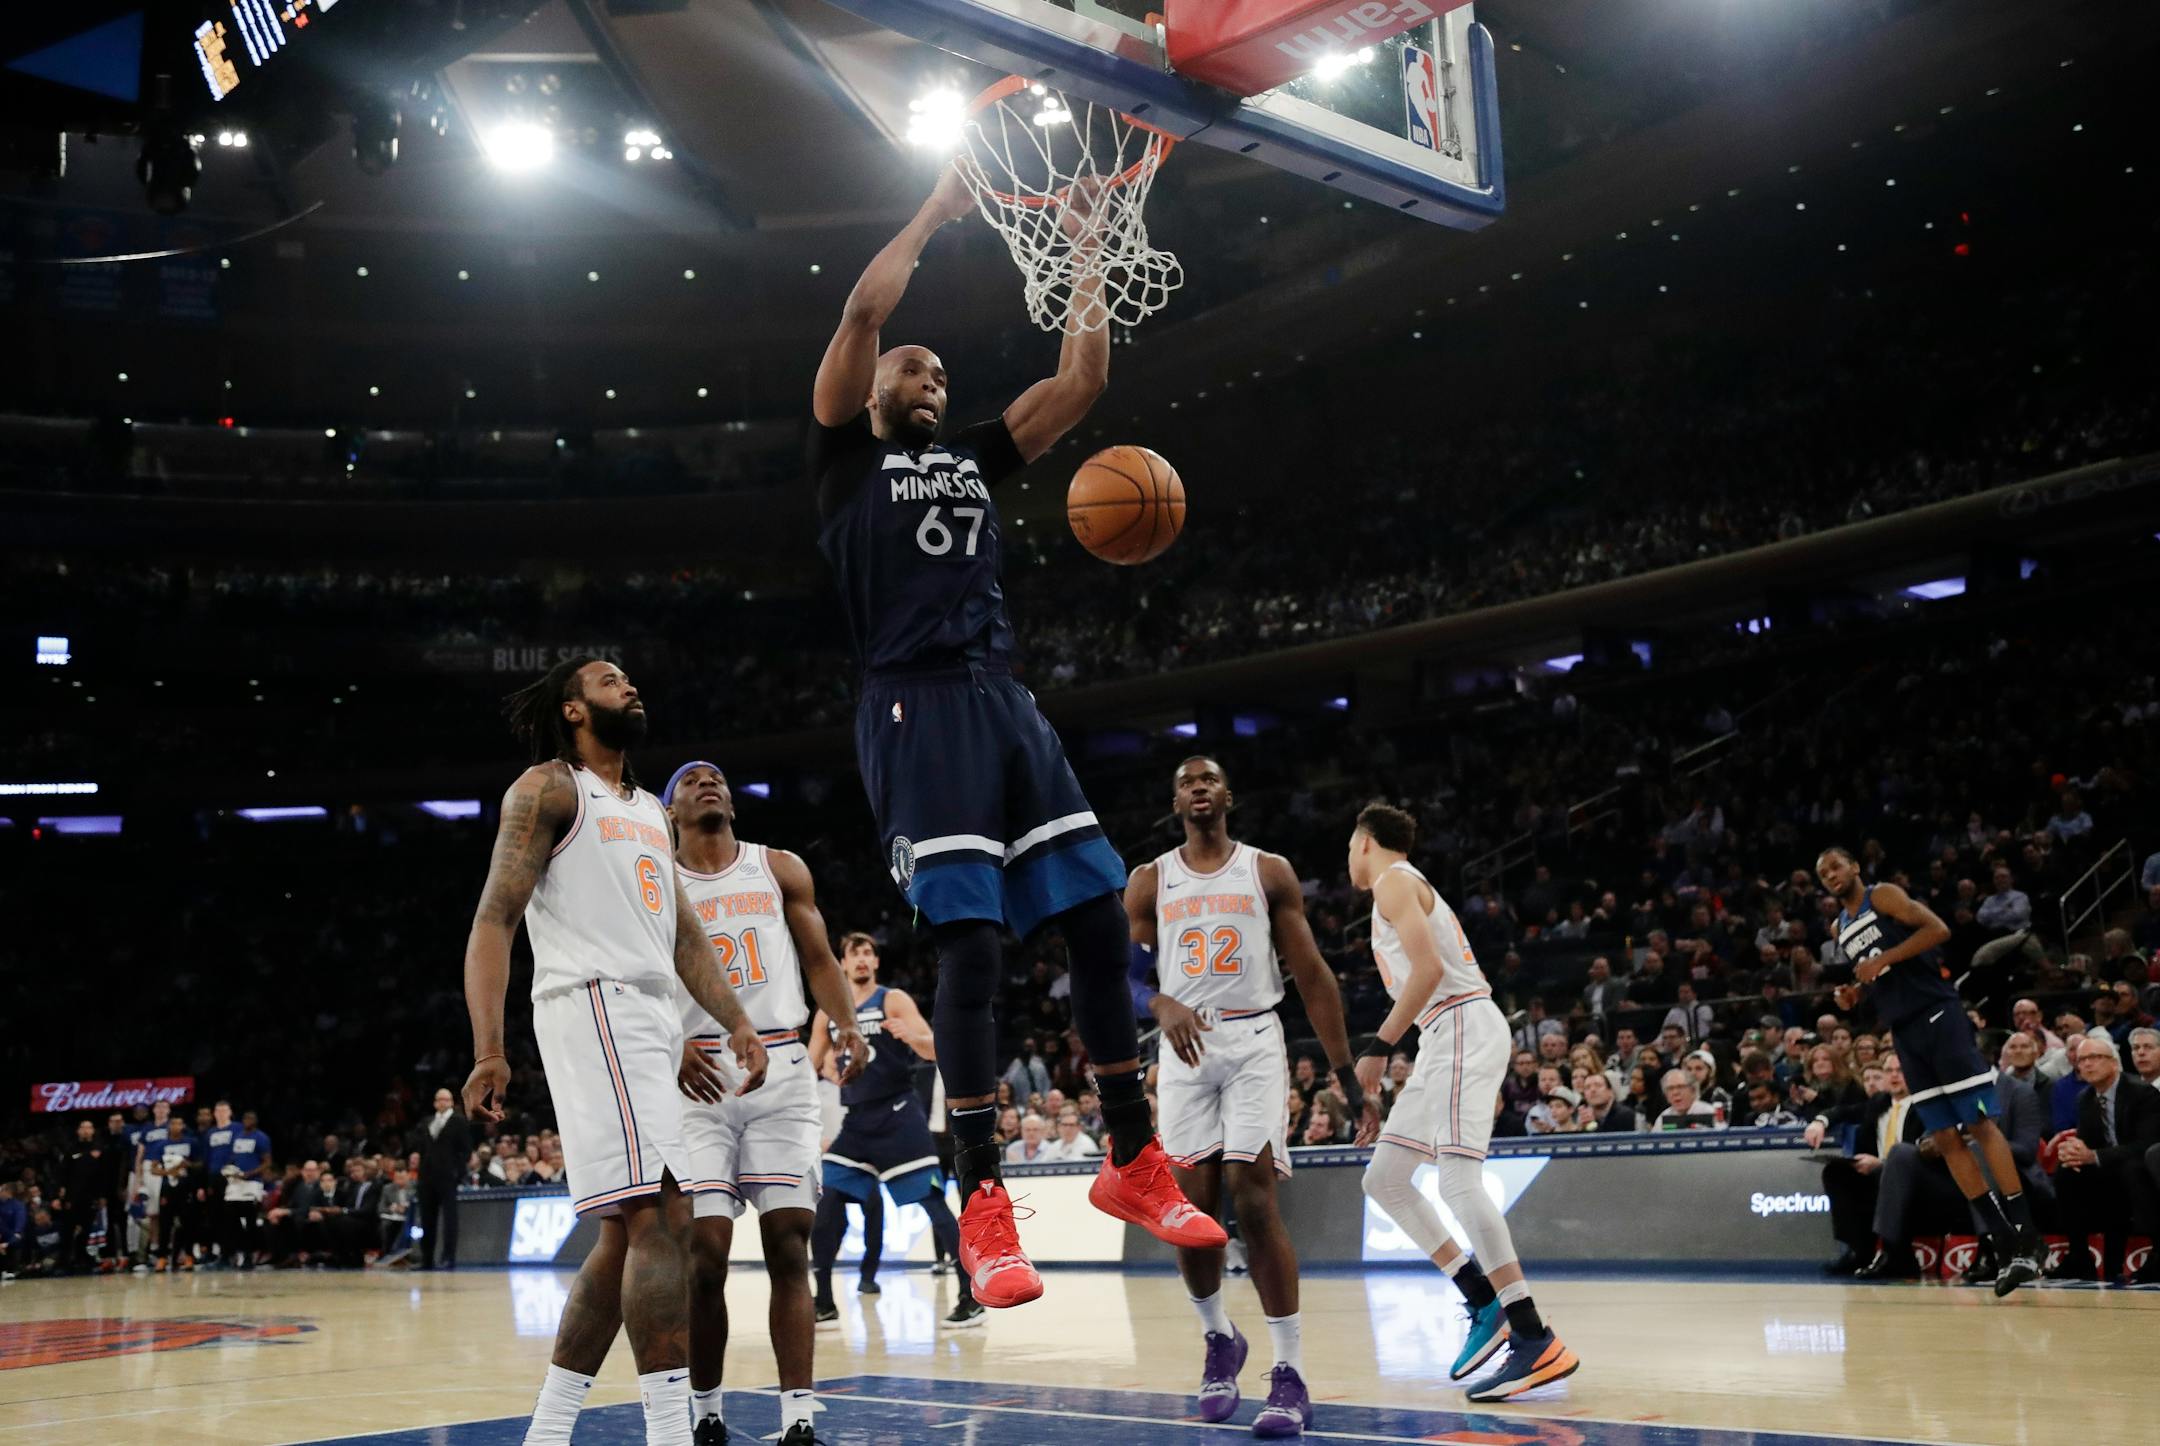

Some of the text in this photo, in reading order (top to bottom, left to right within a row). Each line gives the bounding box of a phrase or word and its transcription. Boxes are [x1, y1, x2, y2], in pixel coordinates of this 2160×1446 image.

[1413, 125, 1429, 146] NBA
[916, 505, 985, 556] 67
[493, 647, 547, 672] BLUE
[635, 855, 663, 915] 6
[720, 891, 778, 920] YORK
[1162, 893, 1257, 927] NEW YORK
[709, 928, 768, 988] 21
[1179, 925, 1242, 979] 32
[40, 1081, 188, 1112] Budweiser
